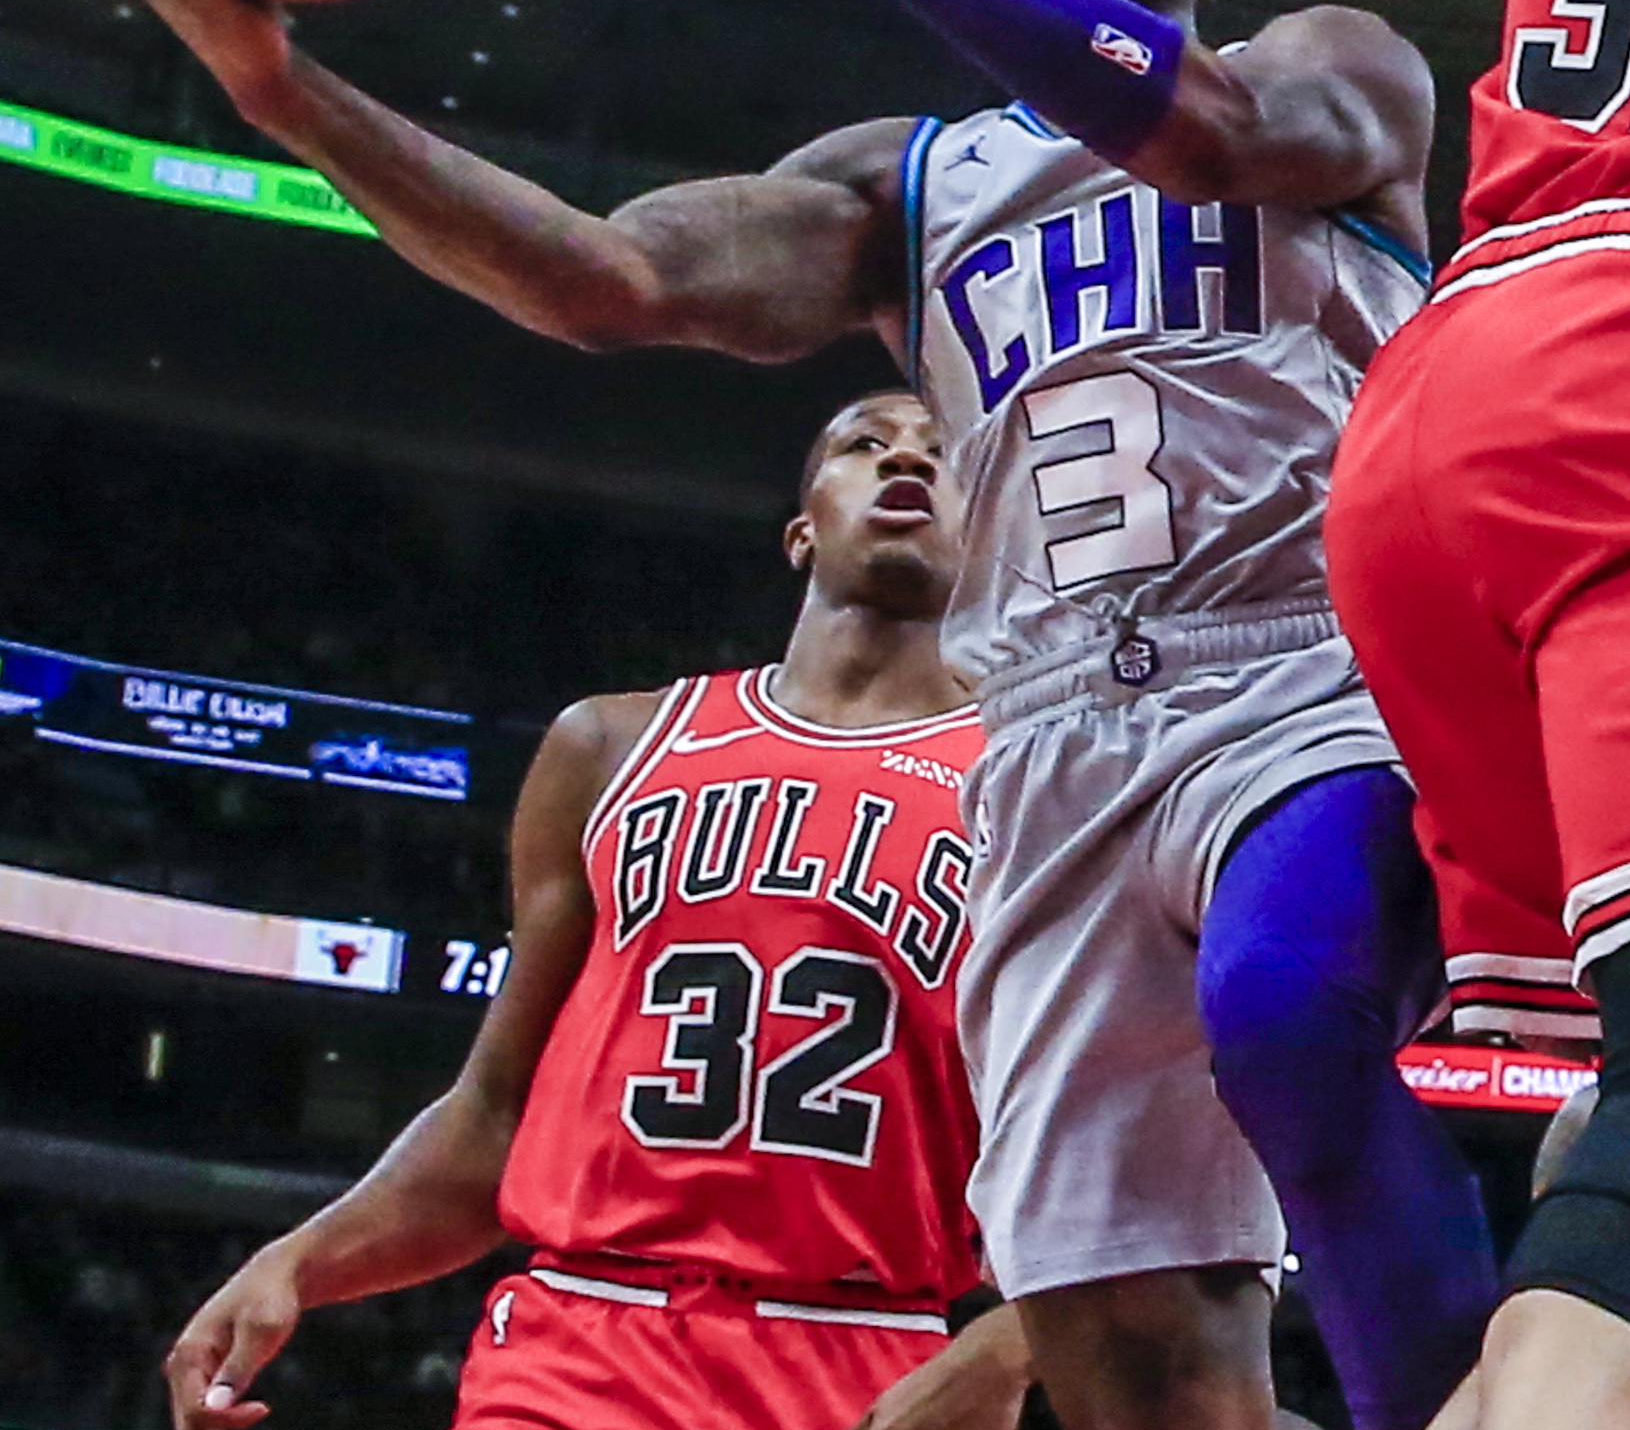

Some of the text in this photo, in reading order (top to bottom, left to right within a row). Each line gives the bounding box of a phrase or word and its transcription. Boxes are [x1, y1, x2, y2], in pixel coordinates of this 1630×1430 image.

[1020, 369, 1180, 593] 3
[440, 940, 510, 997] 7:1
[612, 776, 972, 990] BULLS
[621, 942, 900, 1168] 32
